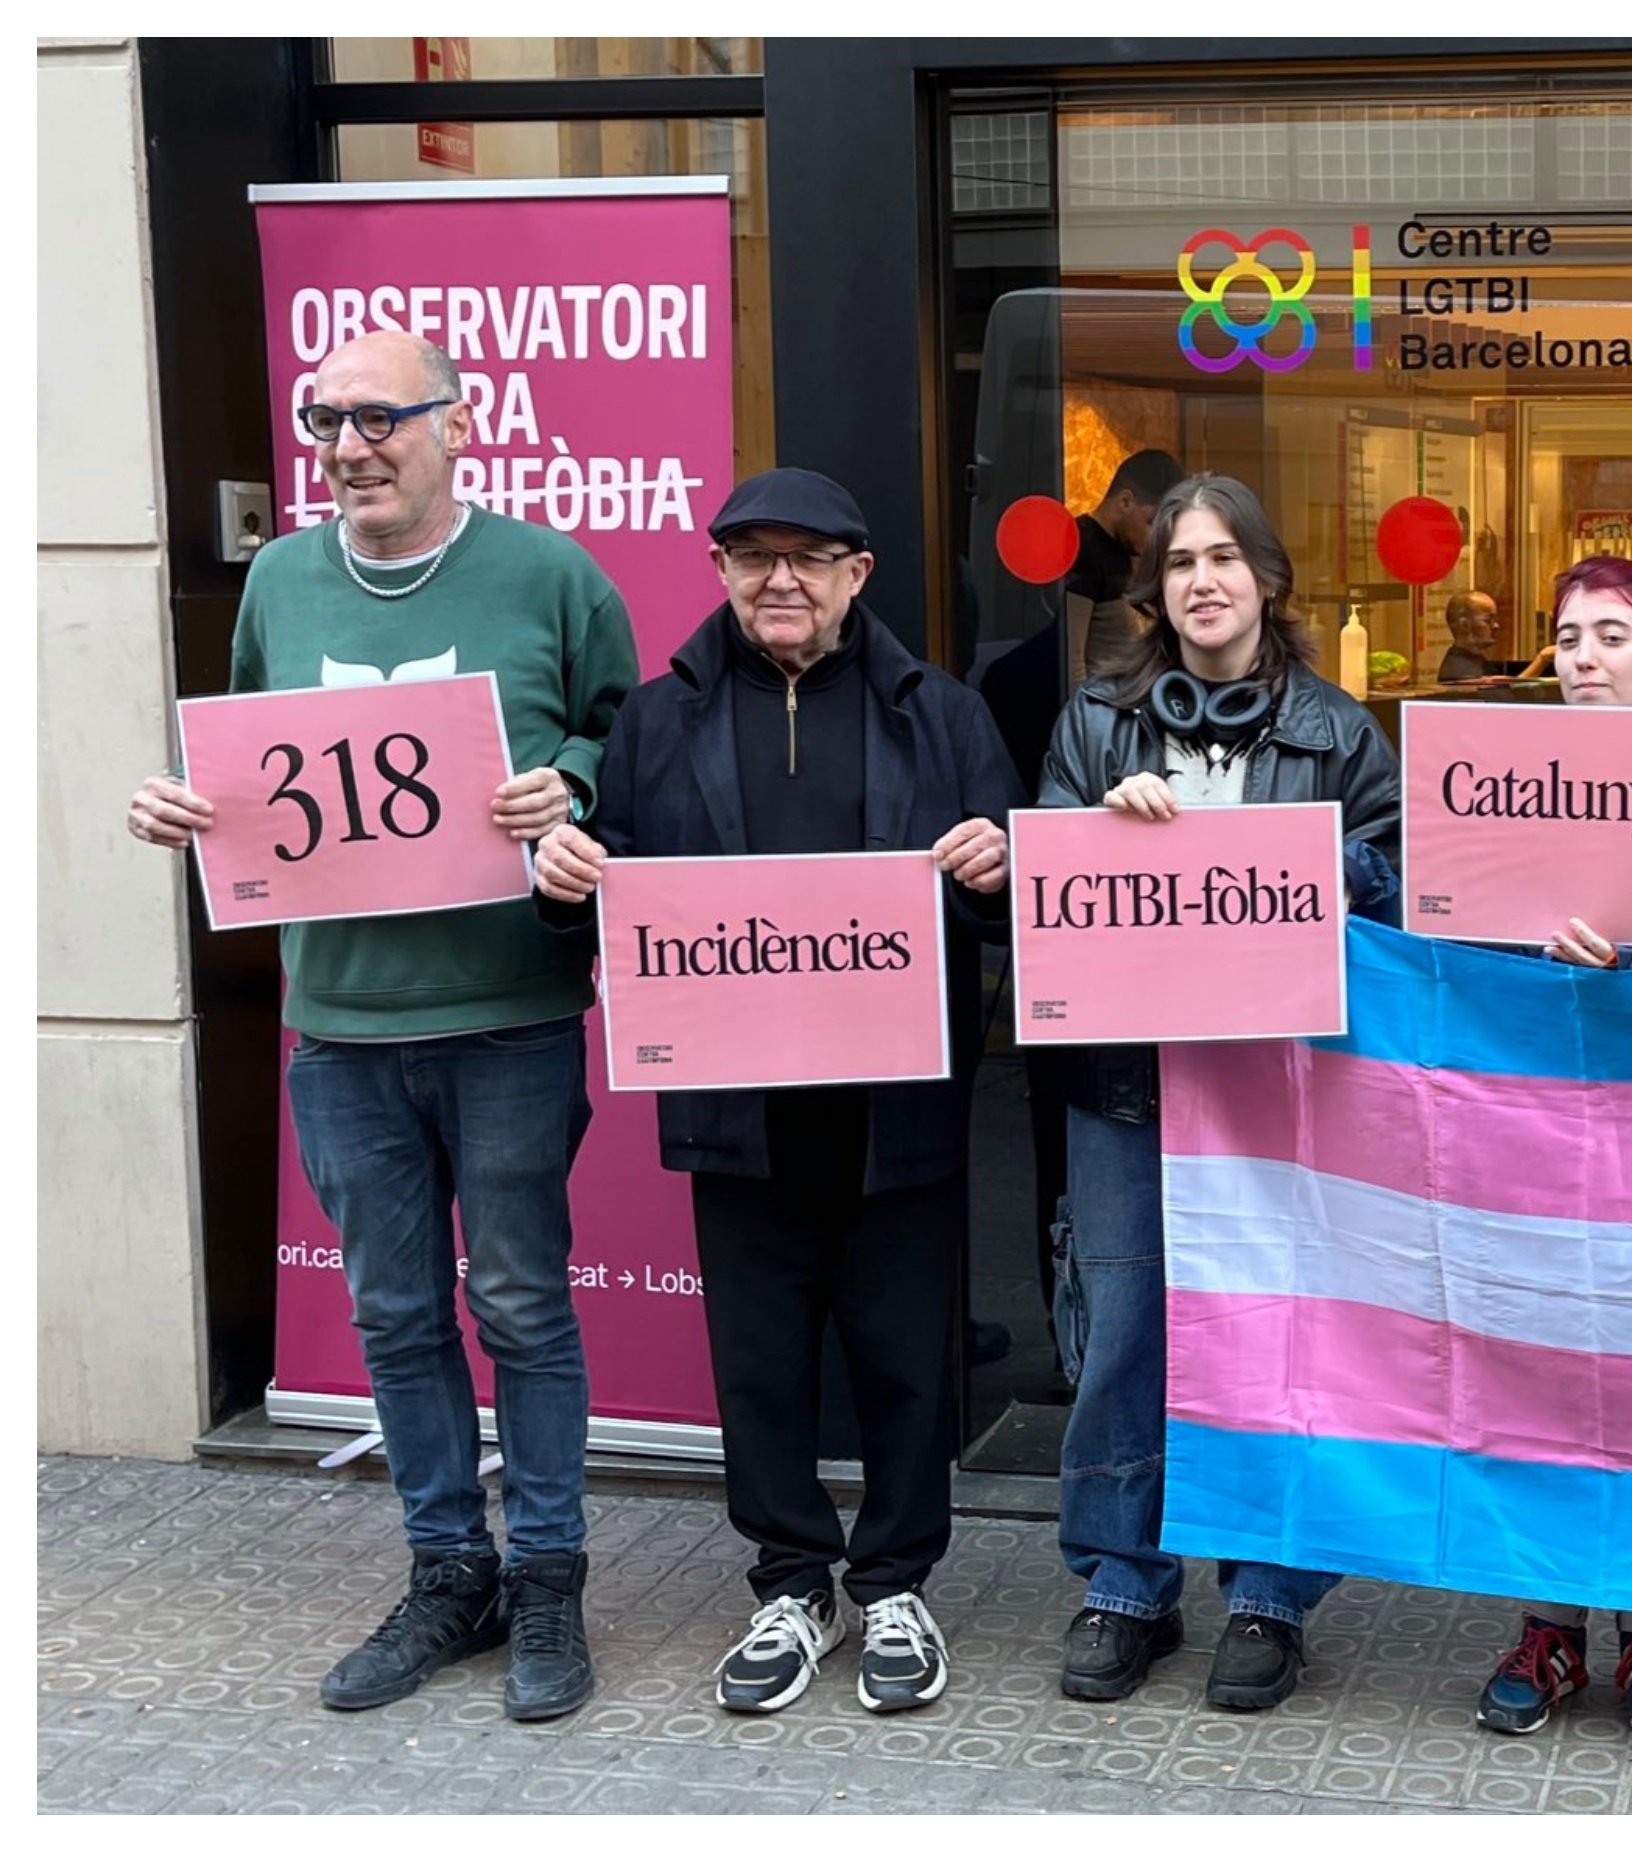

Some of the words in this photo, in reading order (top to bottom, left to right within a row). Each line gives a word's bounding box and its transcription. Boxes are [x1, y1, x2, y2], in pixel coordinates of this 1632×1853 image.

[1398, 221, 1551, 259] Centre
[291, 283, 707, 362] OBSERVATORI
[1400, 276, 1529, 316] LGTBI
[1400, 331, 1632, 371] Barcelona
[292, 371, 541, 446] CRA
[260, 732, 442, 862] 318
[1031, 866, 1325, 929] LGTBI-fòbia
[633, 917, 912, 979] Incidències
